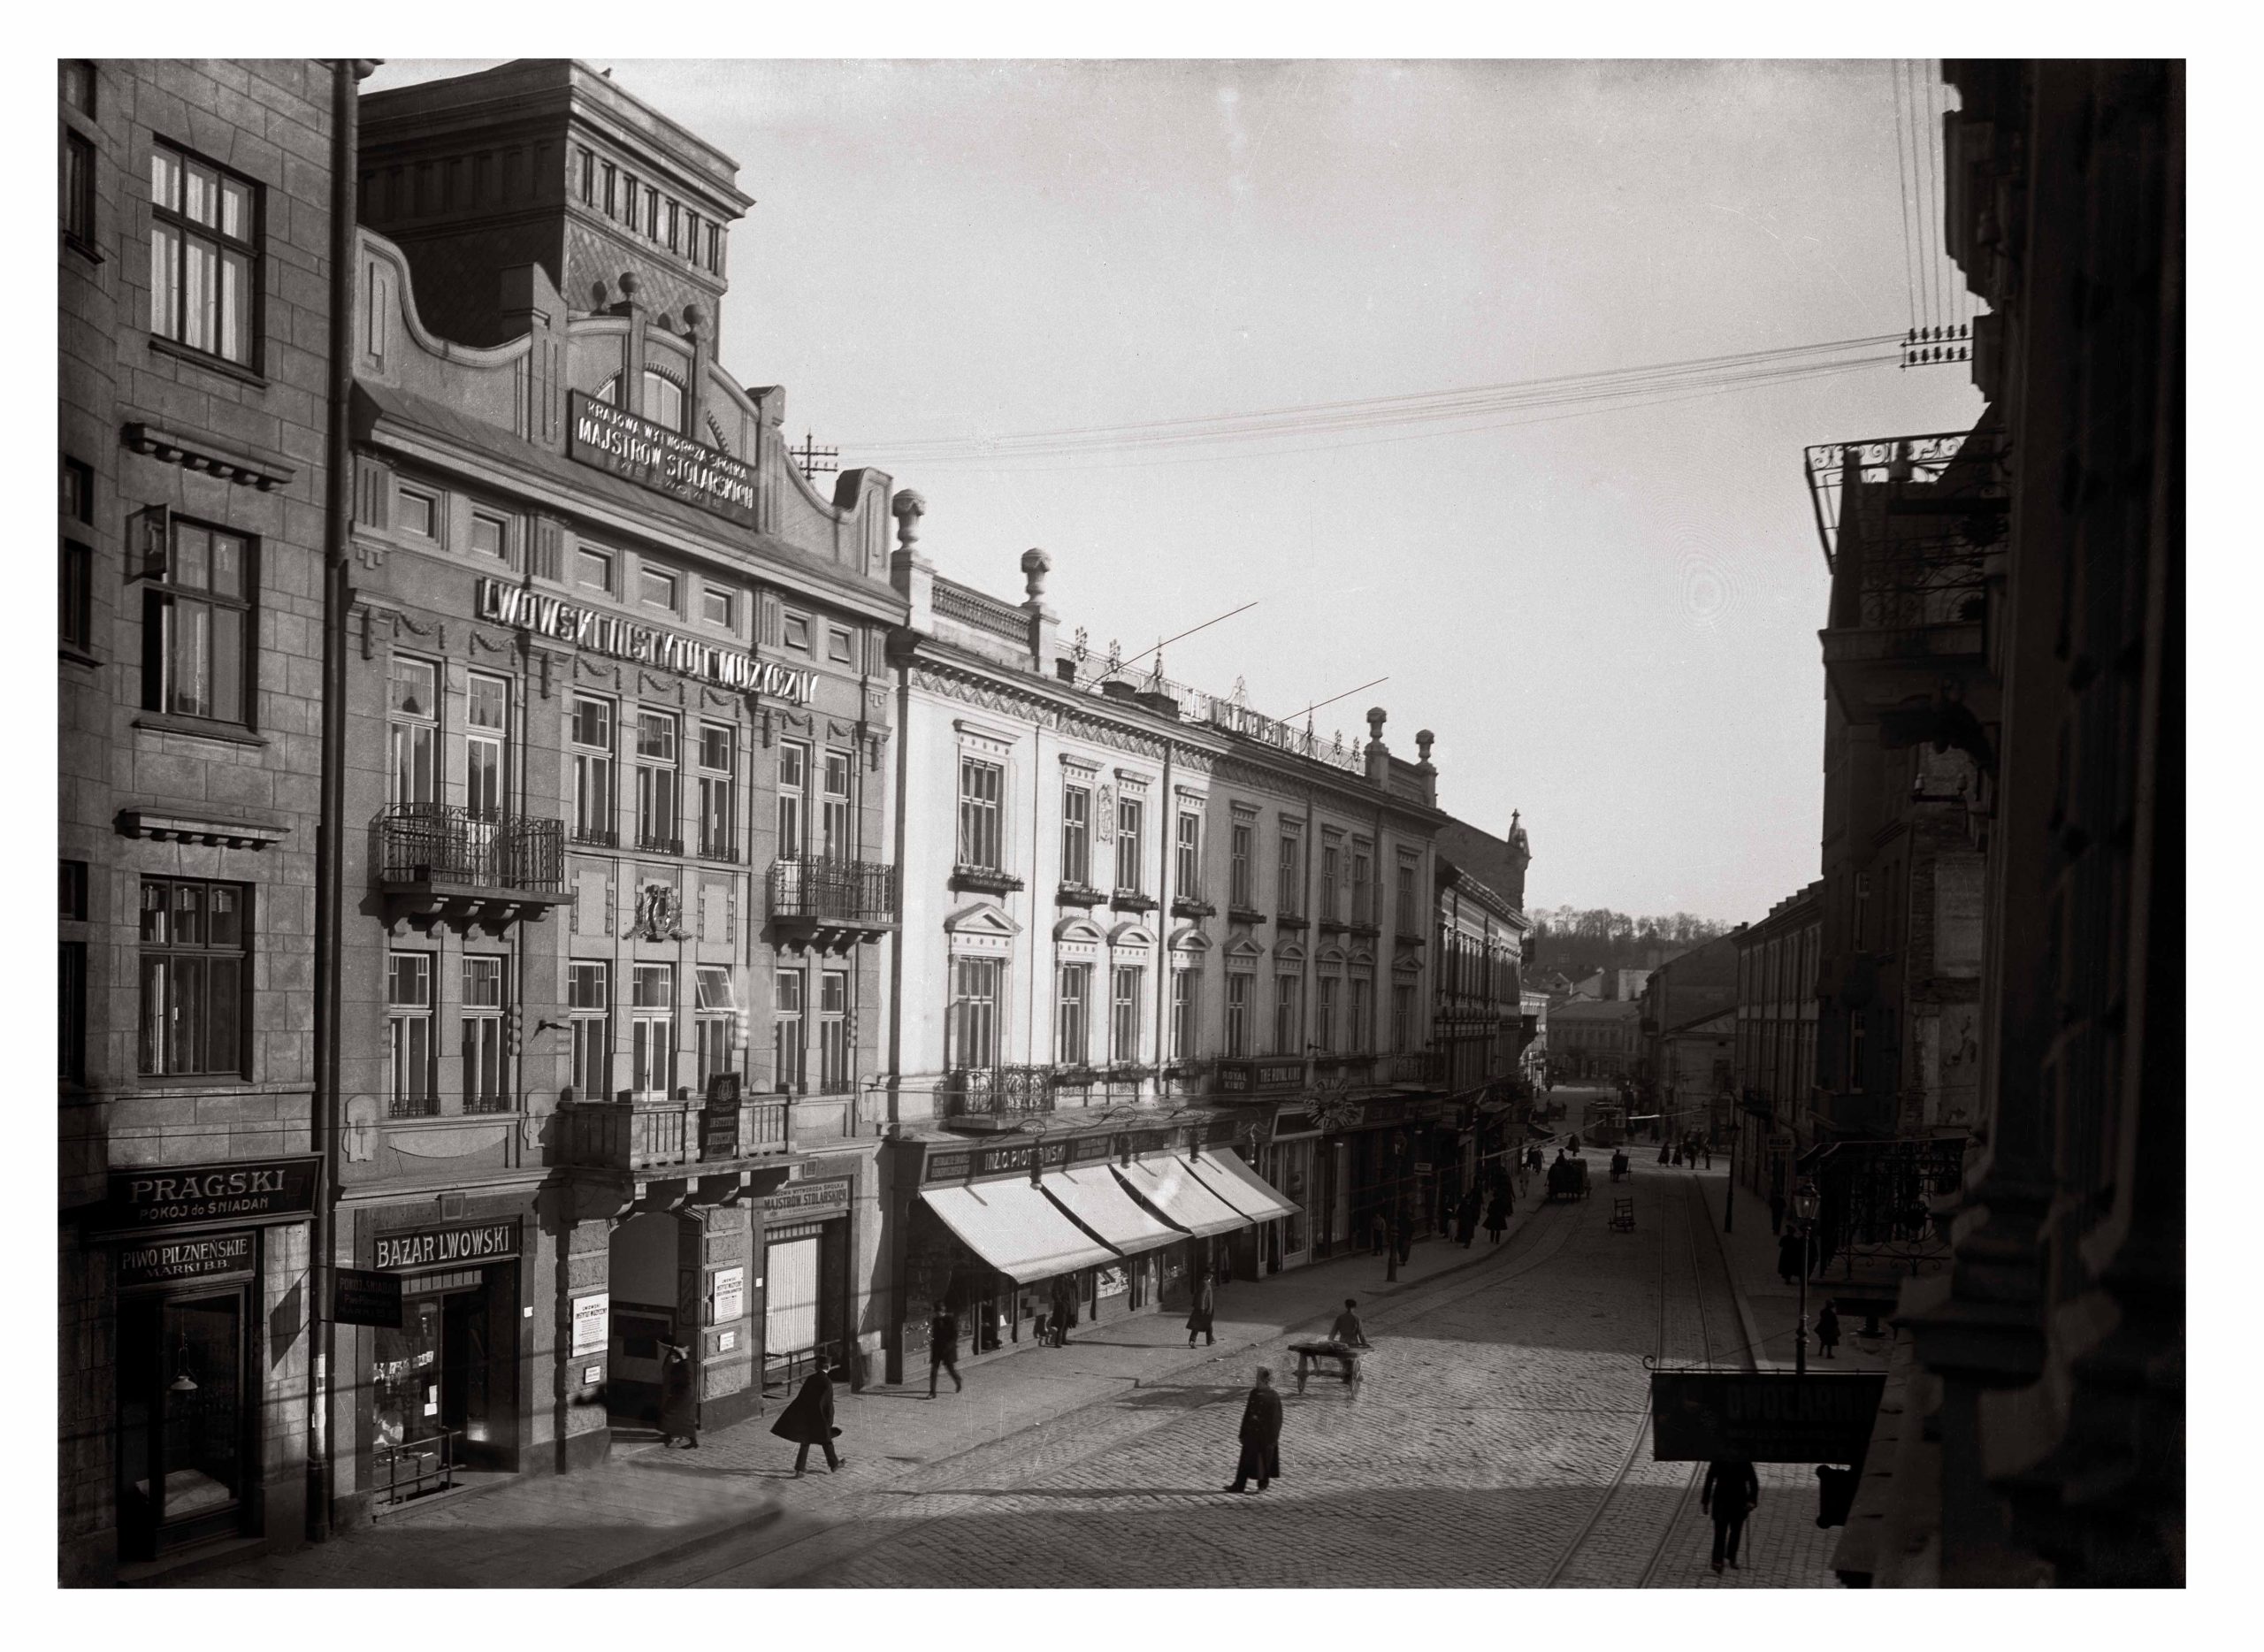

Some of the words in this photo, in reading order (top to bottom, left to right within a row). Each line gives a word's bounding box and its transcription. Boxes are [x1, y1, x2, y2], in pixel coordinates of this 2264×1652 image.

[587, 401, 640, 434] KRAJOWA
[666, 455, 753, 509] STOLARSKICH
[482, 577, 602, 649] LWOWSKI
[608, 618, 714, 679] INSTYTUT
[718, 651, 820, 704] MUZYCZNY
[129, 1169, 287, 1204] PRAGSKI
[139, 1204, 189, 1221] POKÓJ
[191, 1204, 205, 1216] do
[207, 1197, 270, 1215] ŚNIADAŃ
[122, 1248, 158, 1270] PIWO
[162, 1238, 249, 1265] PILZNEŃSKIE
[377, 1236, 434, 1268] BAZAR
[439, 1226, 509, 1260] LWOWSKI
[143, 1264, 201, 1278] MARKI
[204, 1259, 231, 1271] B.B.
